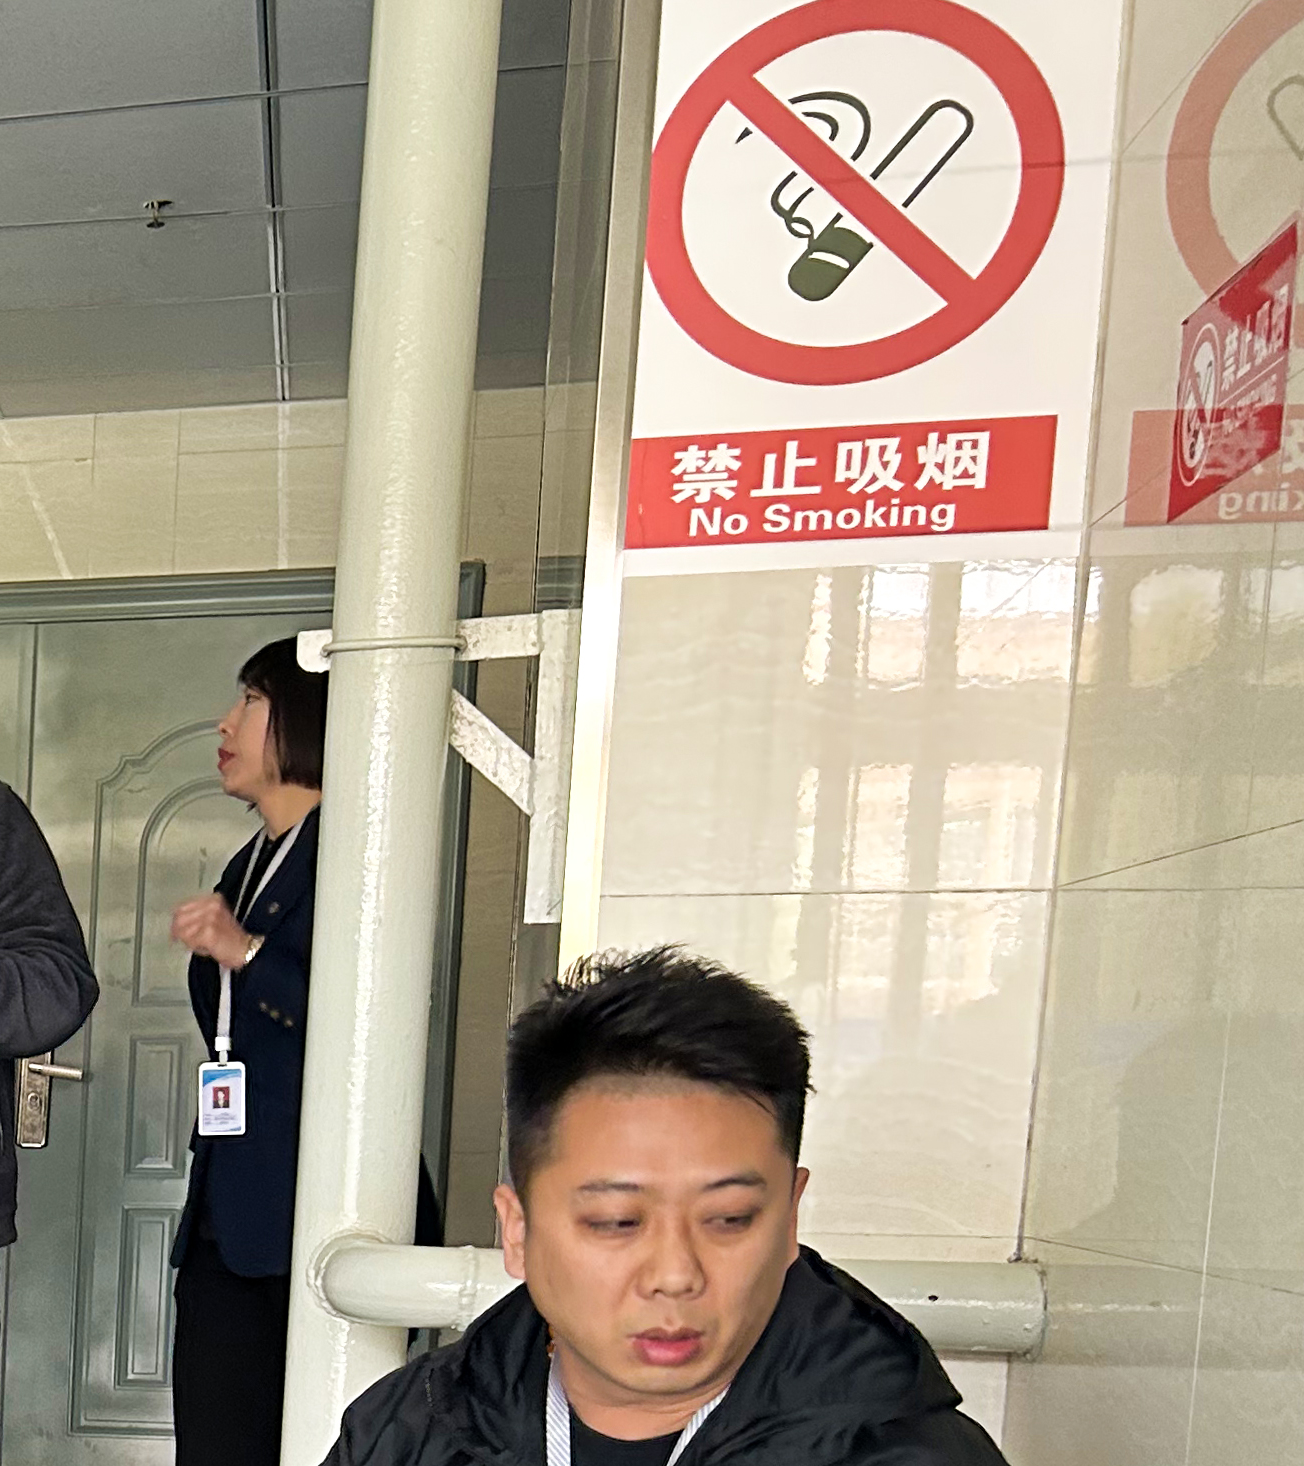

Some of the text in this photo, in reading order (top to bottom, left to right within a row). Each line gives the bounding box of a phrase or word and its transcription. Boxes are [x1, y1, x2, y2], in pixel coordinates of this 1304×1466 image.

[671, 431, 990, 504] 禁止吸烟
[689, 499, 956, 537] No Smoking
